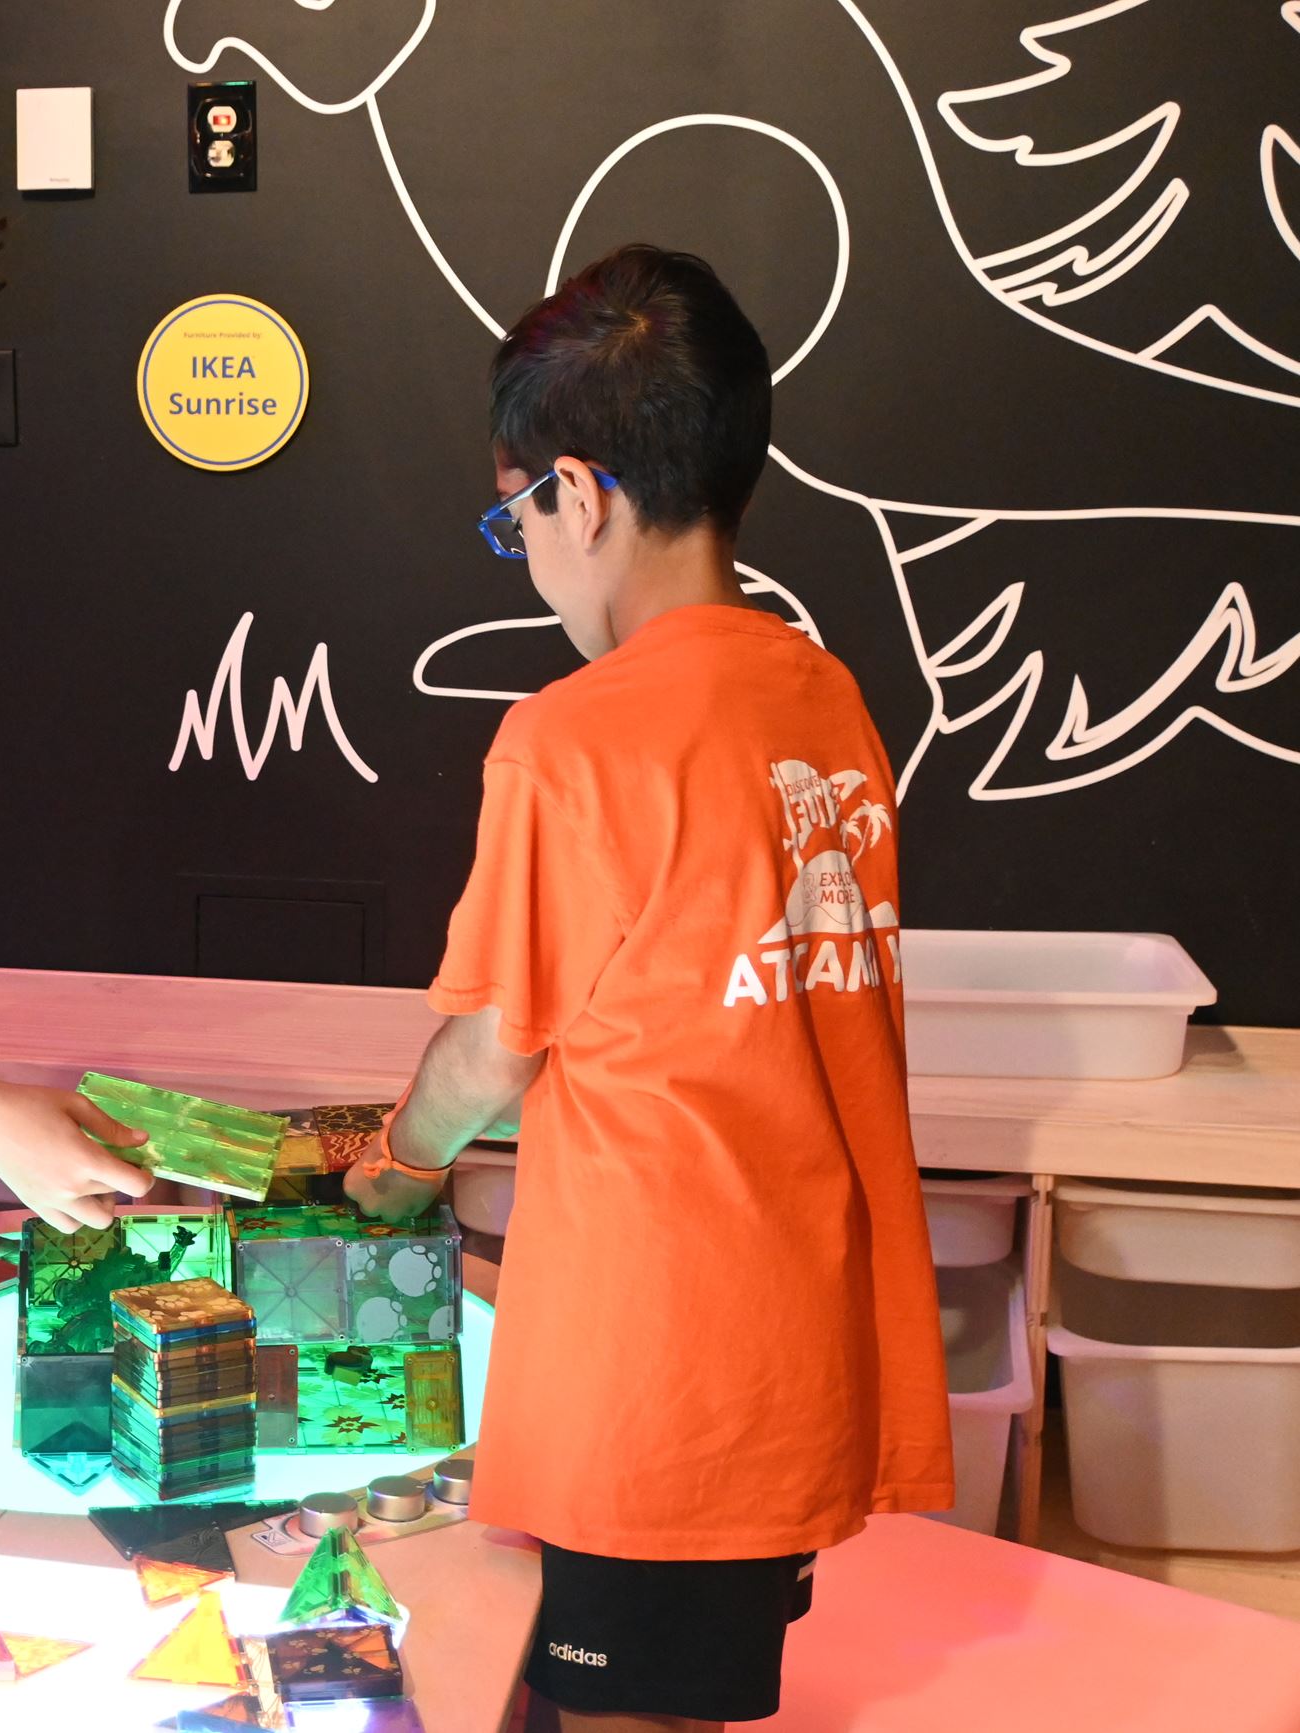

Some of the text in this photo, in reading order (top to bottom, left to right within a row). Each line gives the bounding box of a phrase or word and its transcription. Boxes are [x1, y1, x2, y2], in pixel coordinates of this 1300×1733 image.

[191, 356, 256, 379] IKEA
[169, 392, 277, 416] Sunrise
[786, 775, 821, 797] DISCOVE
[549, 1642, 608, 1668] adidas
